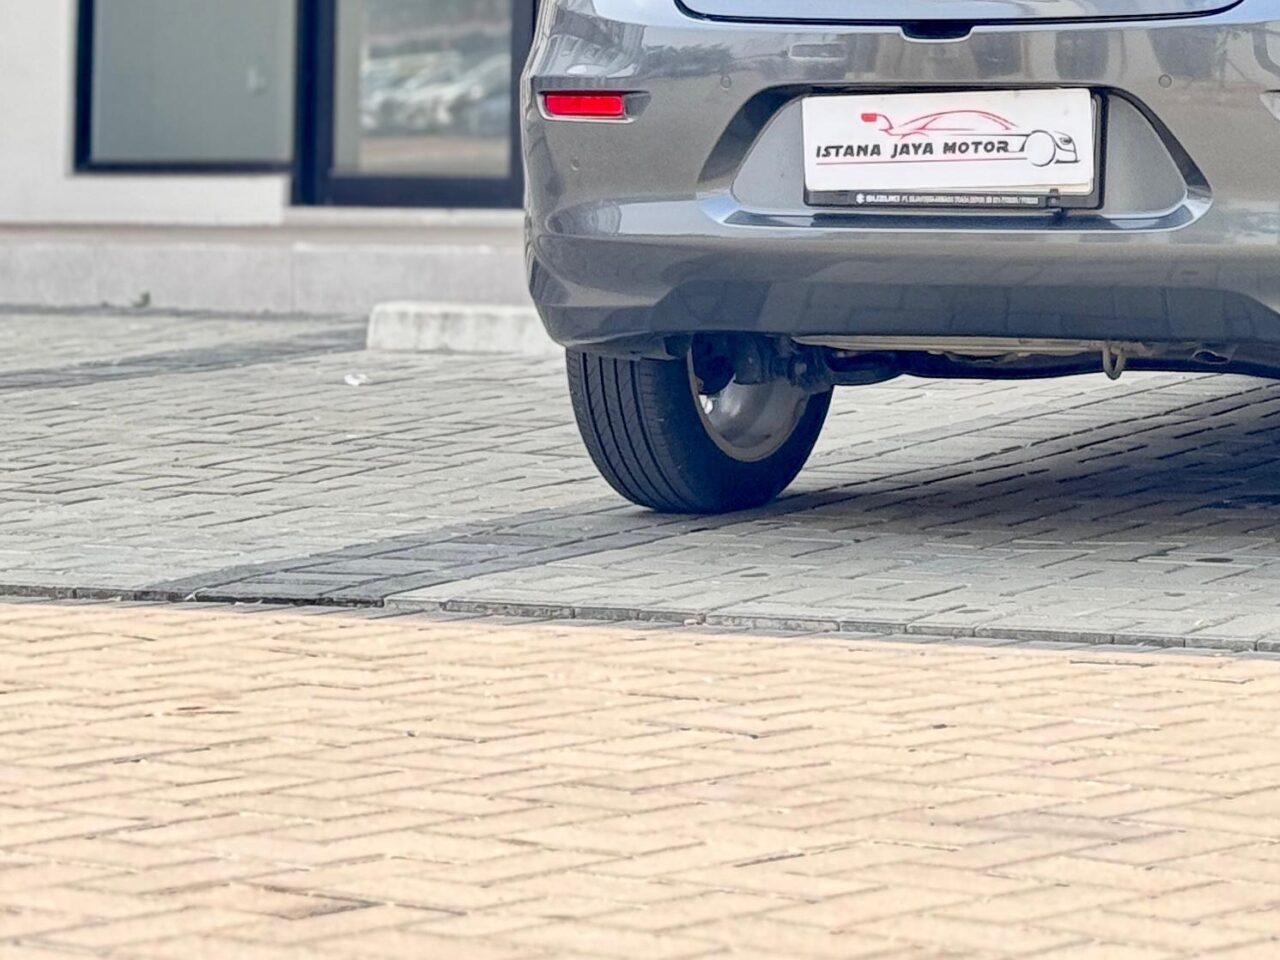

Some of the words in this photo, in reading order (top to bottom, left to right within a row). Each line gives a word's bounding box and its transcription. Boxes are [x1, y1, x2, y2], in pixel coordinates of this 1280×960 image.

[815, 144, 881, 159] ISTANA
[891, 141, 934, 158] JAYA
[942, 139, 1009, 154] MOTOR
